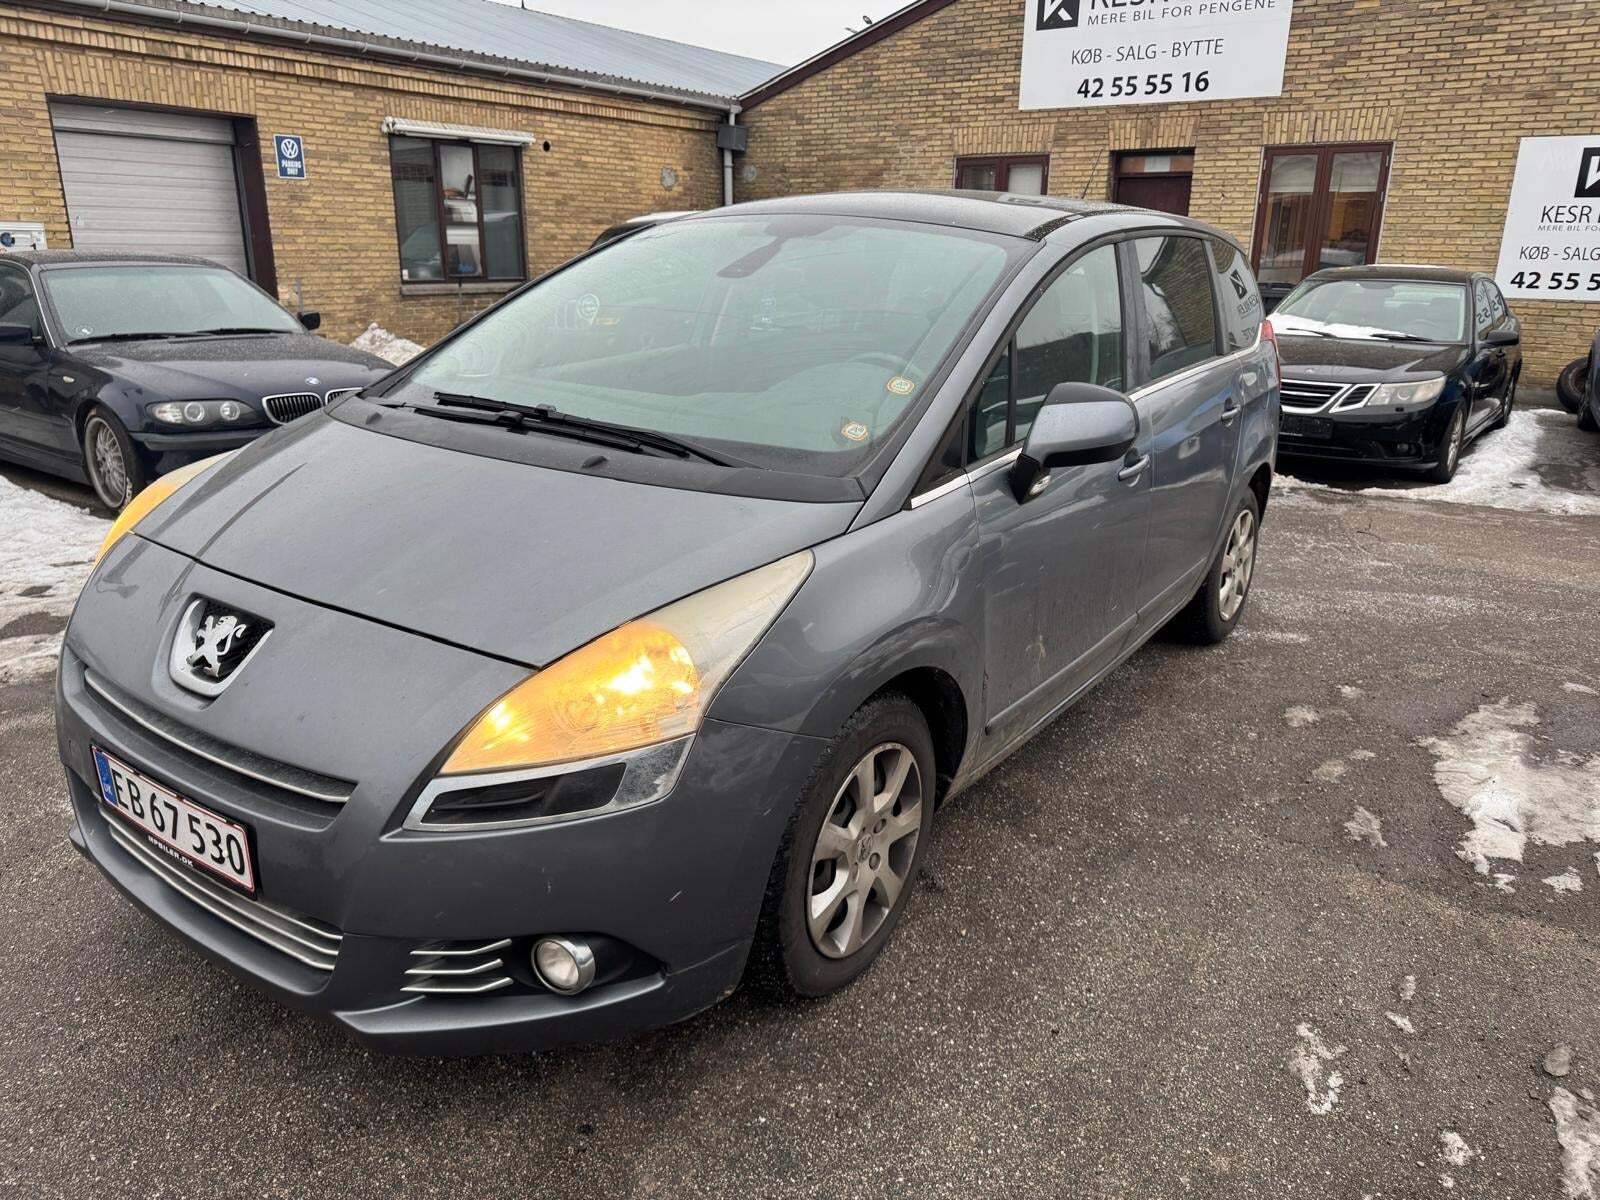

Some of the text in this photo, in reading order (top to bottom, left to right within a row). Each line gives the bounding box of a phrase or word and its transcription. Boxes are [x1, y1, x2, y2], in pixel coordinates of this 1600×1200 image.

[1087, 12, 1127, 25] MERE
[1133, 9, 1155, 21] BIL
[1161, 5, 1192, 18] FOR
[1199, 0, 1275, 15] PENGENE
[1071, 48, 1102, 65] KØB
[1116, 43, 1157, 62] SALG
[1171, 38, 1224, 57] BYTTE
[1077, 71, 1210, 98] 42 55 55 16
[1540, 205, 1592, 224] KESR
[1519, 246, 1550, 261] KØB
[1562, 246, 1600, 261] SALG
[1510, 271, 1541, 289] 42
[1547, 272, 1581, 290] 55
[111, 768, 245, 875] EB 67 530
